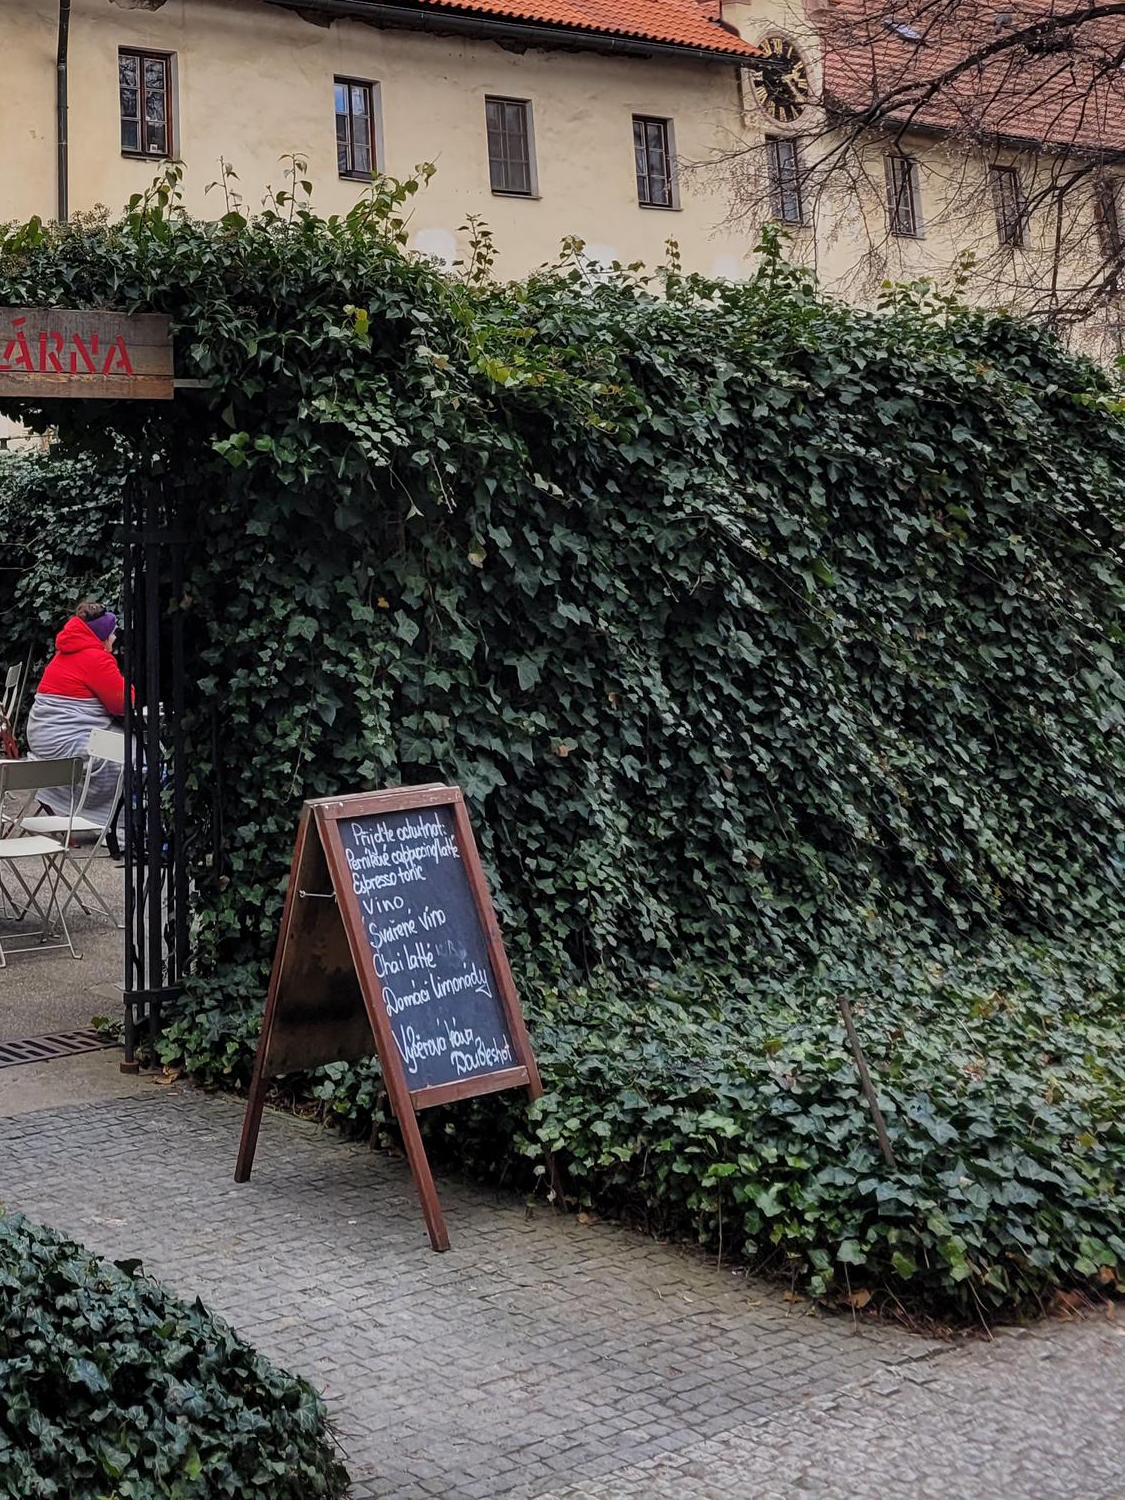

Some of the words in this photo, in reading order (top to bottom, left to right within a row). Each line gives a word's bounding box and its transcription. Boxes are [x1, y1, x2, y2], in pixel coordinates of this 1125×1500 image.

[352, 872, 397, 897] Espresso
[398, 864, 427, 884] tonic
[373, 951, 404, 978] Chai
[430, 962, 493, 998] limonády
